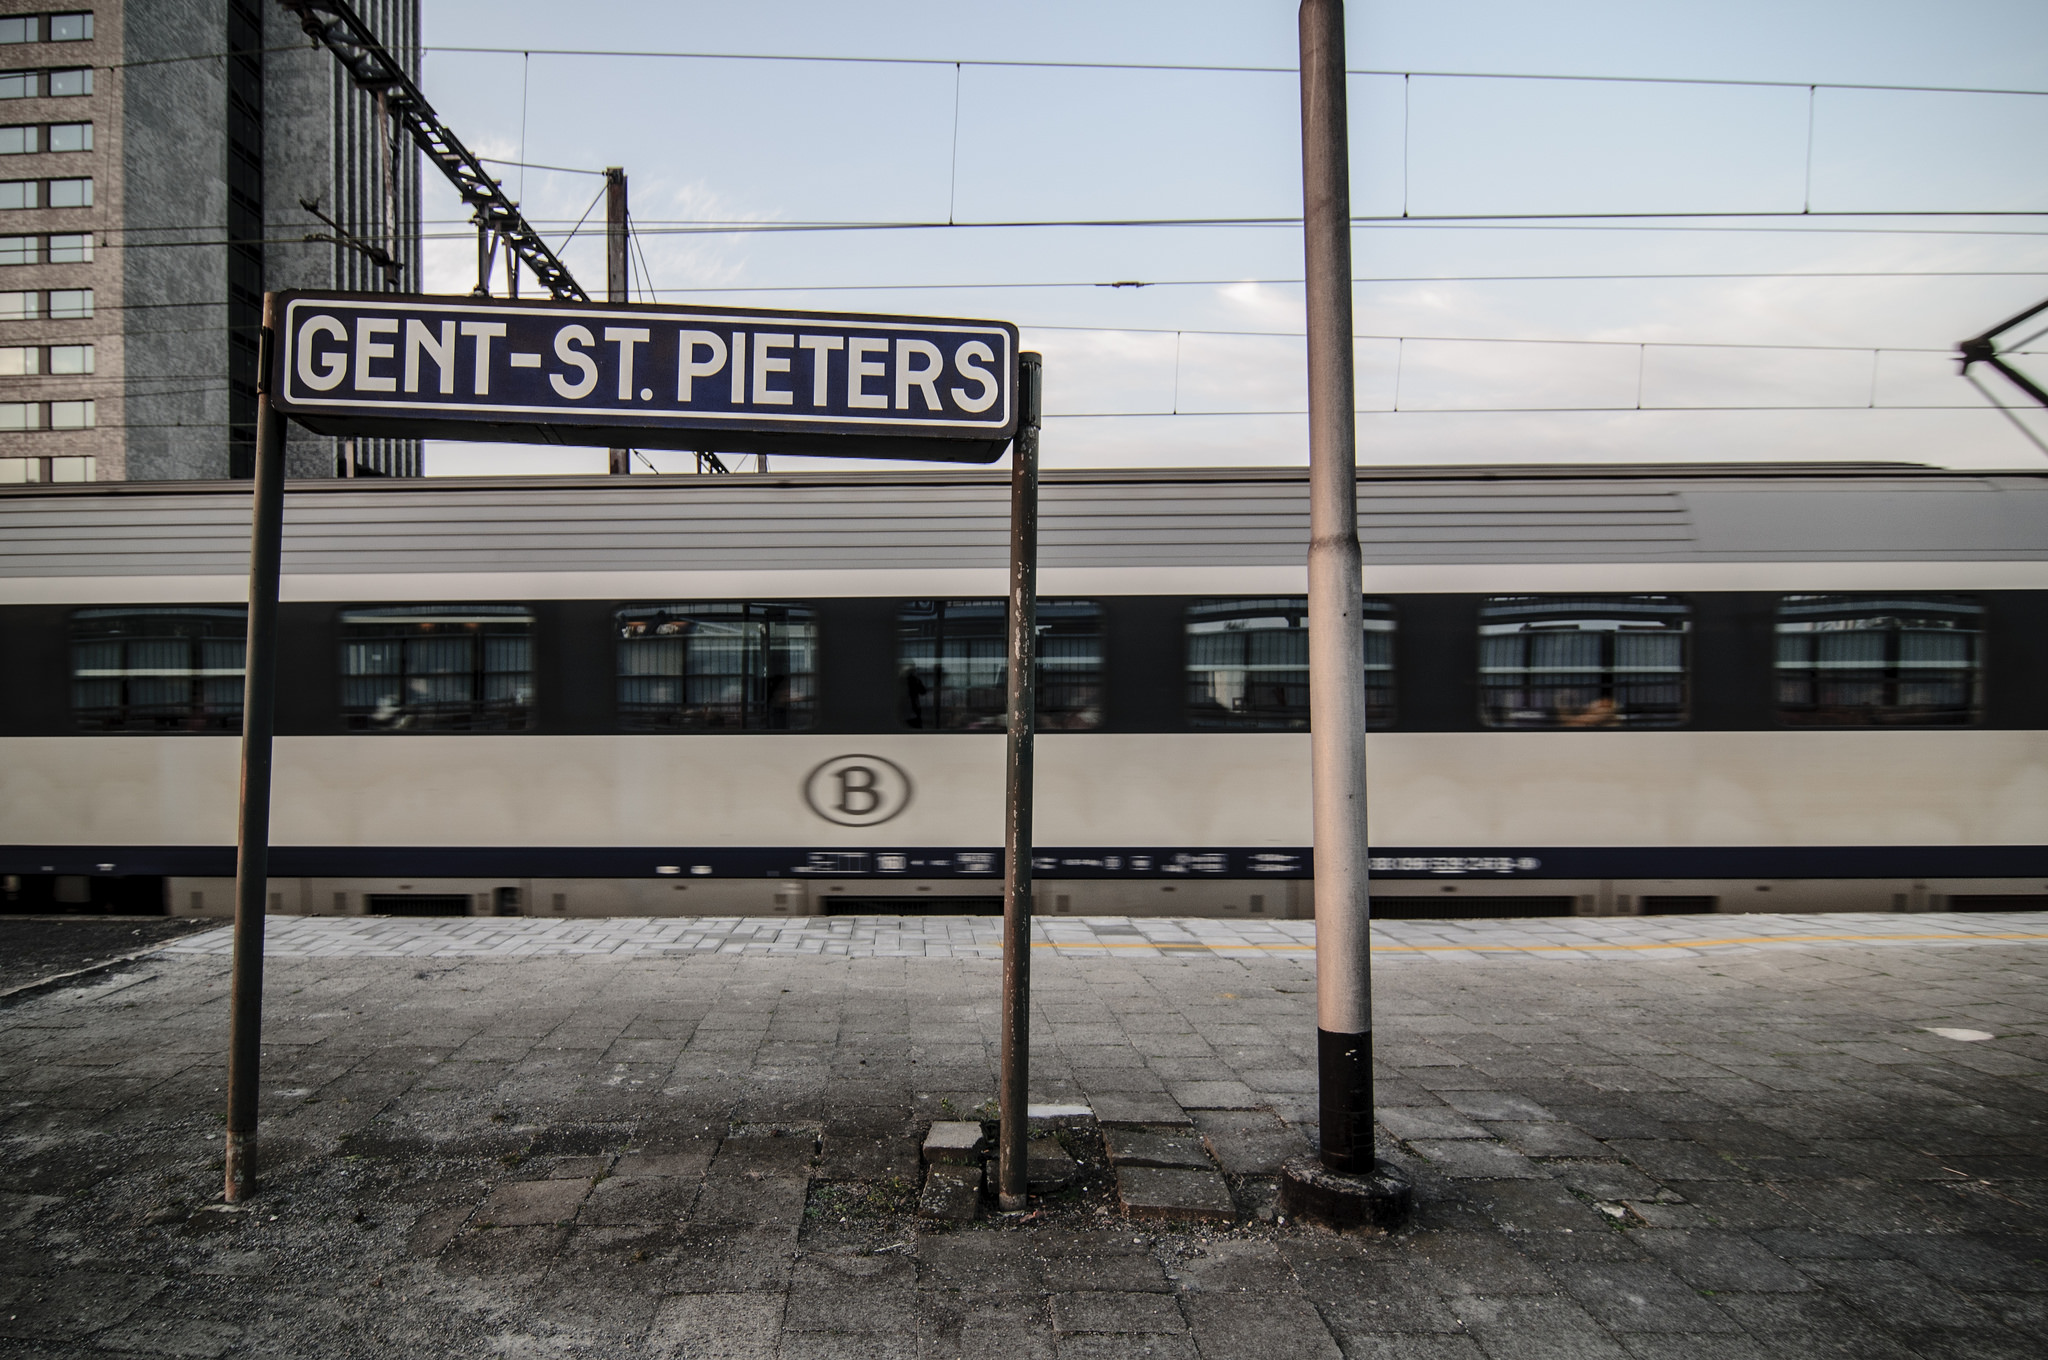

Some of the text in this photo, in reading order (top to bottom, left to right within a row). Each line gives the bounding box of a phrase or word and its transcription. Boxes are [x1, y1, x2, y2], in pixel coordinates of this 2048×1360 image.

[297, 314, 999, 412] GENT-ST. PIETERS
[831, 765, 881, 816] B
